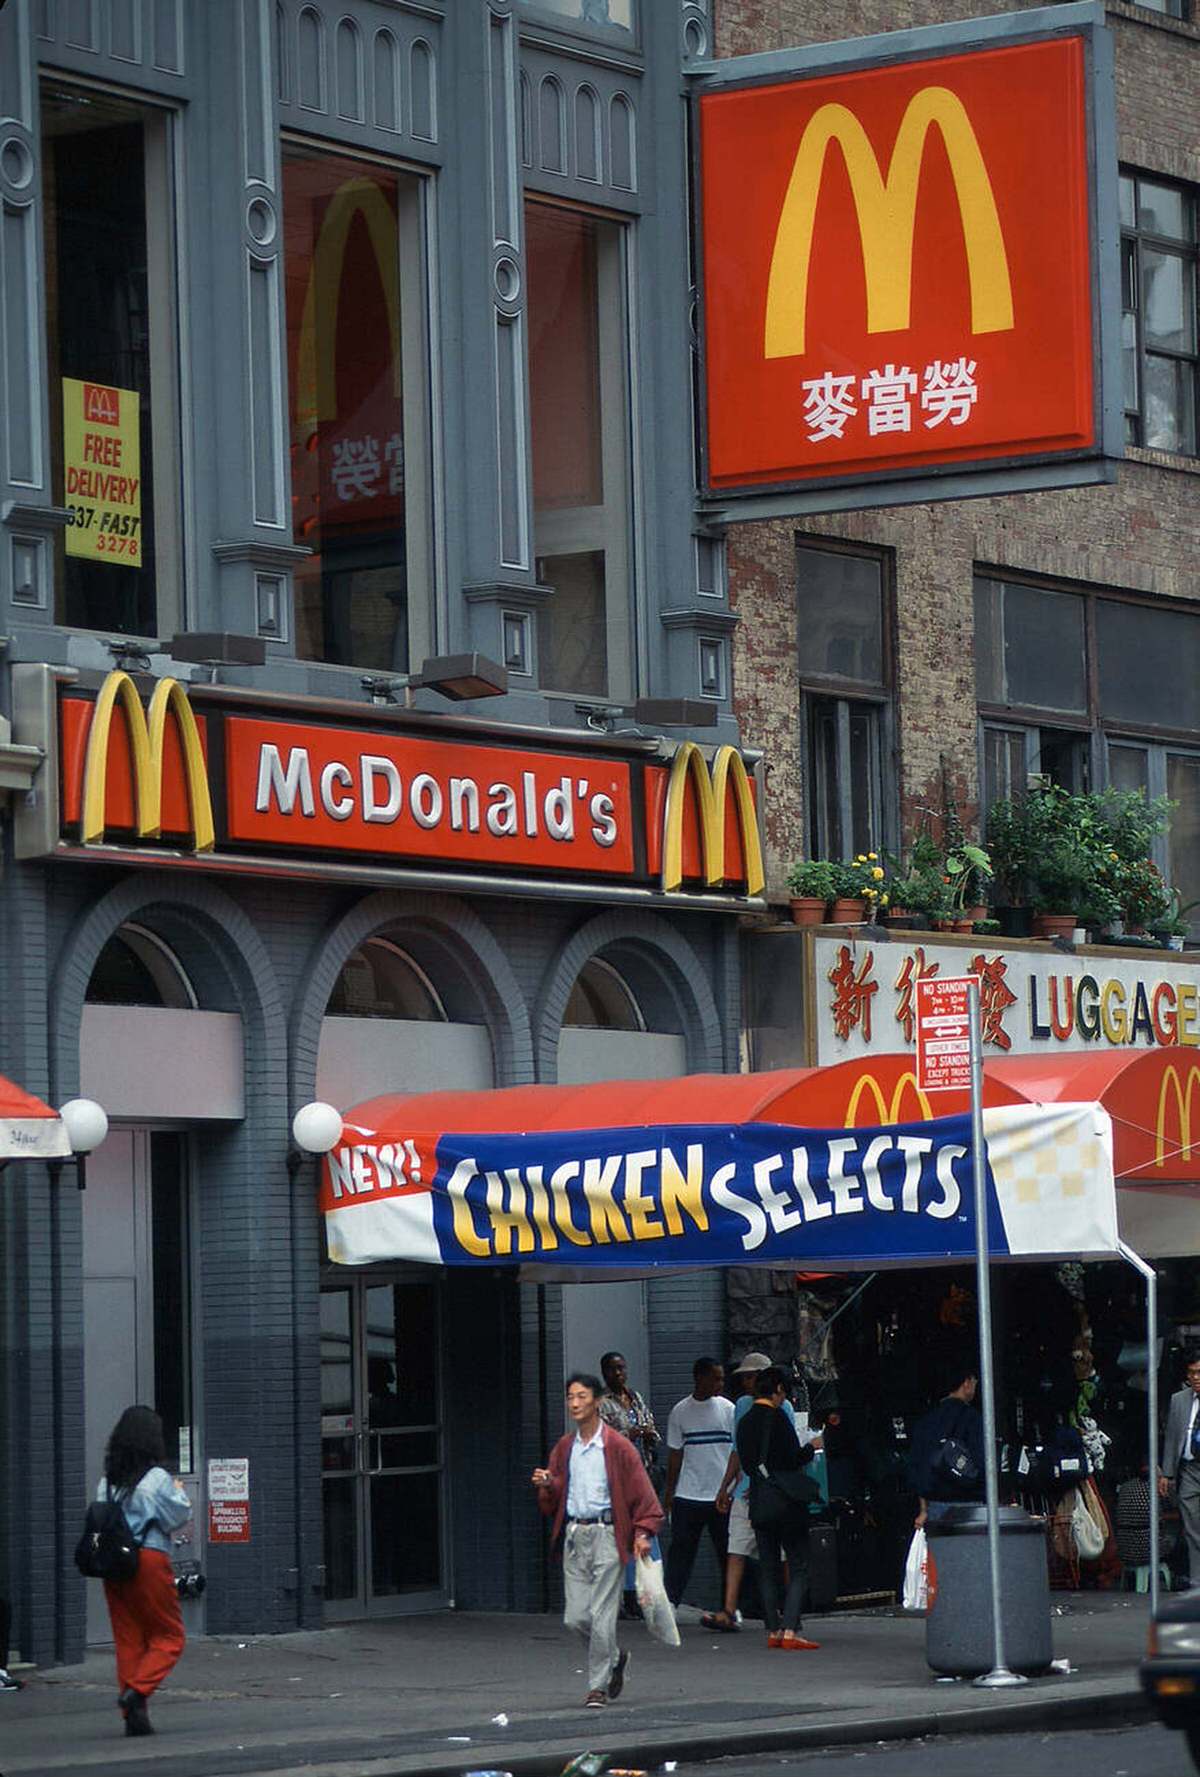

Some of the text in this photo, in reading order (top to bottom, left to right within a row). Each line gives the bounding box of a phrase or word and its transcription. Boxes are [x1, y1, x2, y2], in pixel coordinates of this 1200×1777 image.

[802, 357, 978, 442] 麥當勞
[84, 433, 122, 468] FREE
[67, 467, 139, 505] DELIVERY
[96, 534, 138, 556] 3278
[256, 743, 617, 848] McDonald's
[923, 981, 970, 996] NO STANDIN
[1030, 974, 1200, 1047] LUGGAGE
[925, 1054, 970, 1068] NO STANDIN
[327, 1140, 422, 1198] NEW!
[447, 1144, 709, 1257] CHICKEN
[709, 1135, 968, 1251] SELECTS
